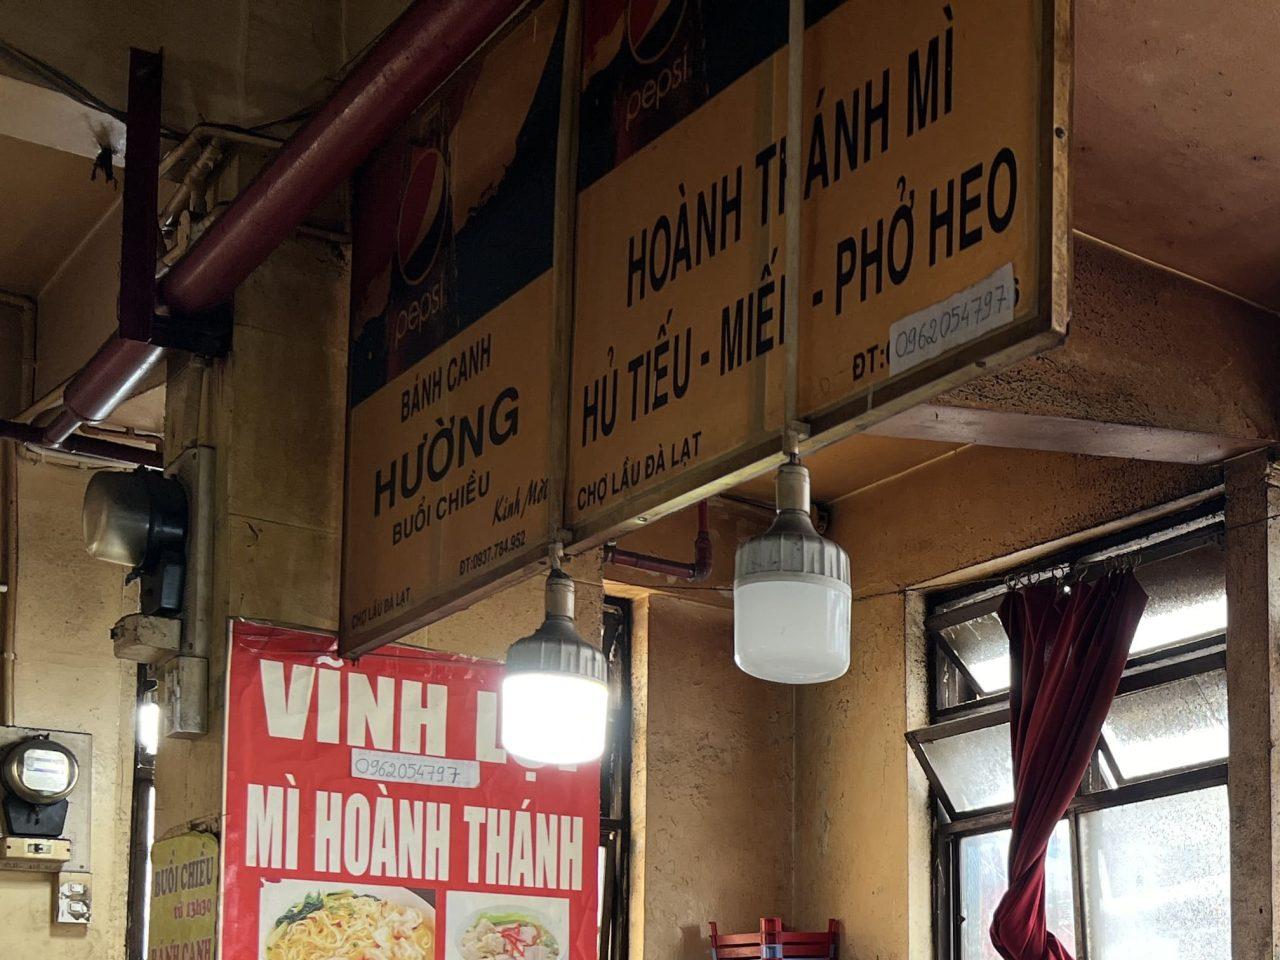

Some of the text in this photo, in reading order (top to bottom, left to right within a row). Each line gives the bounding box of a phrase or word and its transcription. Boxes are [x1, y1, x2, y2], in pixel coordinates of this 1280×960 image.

[625, 44, 689, 131] pepsi
[627, 165, 742, 308] HOÀNH
[906, 4, 953, 137] MÌ
[396, 278, 445, 347] pepsi
[582, 346, 618, 447] HỦ
[628, 307, 692, 422] TIẾU
[835, 175, 915, 316] PHỞ
[929, 147, 1017, 267] HEO
[895, 285, 1007, 358] 0962054797
[401, 333, 491, 423] BÁNH CANH
[374, 387, 519, 518] HƯỜNG
[577, 431, 702, 511] CHỢ LẦU ĐÀ LẠT
[392, 469, 490, 546] BUỔI CHIỀU
[259, 655, 448, 757] VĨNH
[355, 758, 460, 783] 0962054797
[245, 773, 583, 891] MÌ HOÀNH THÁNH
